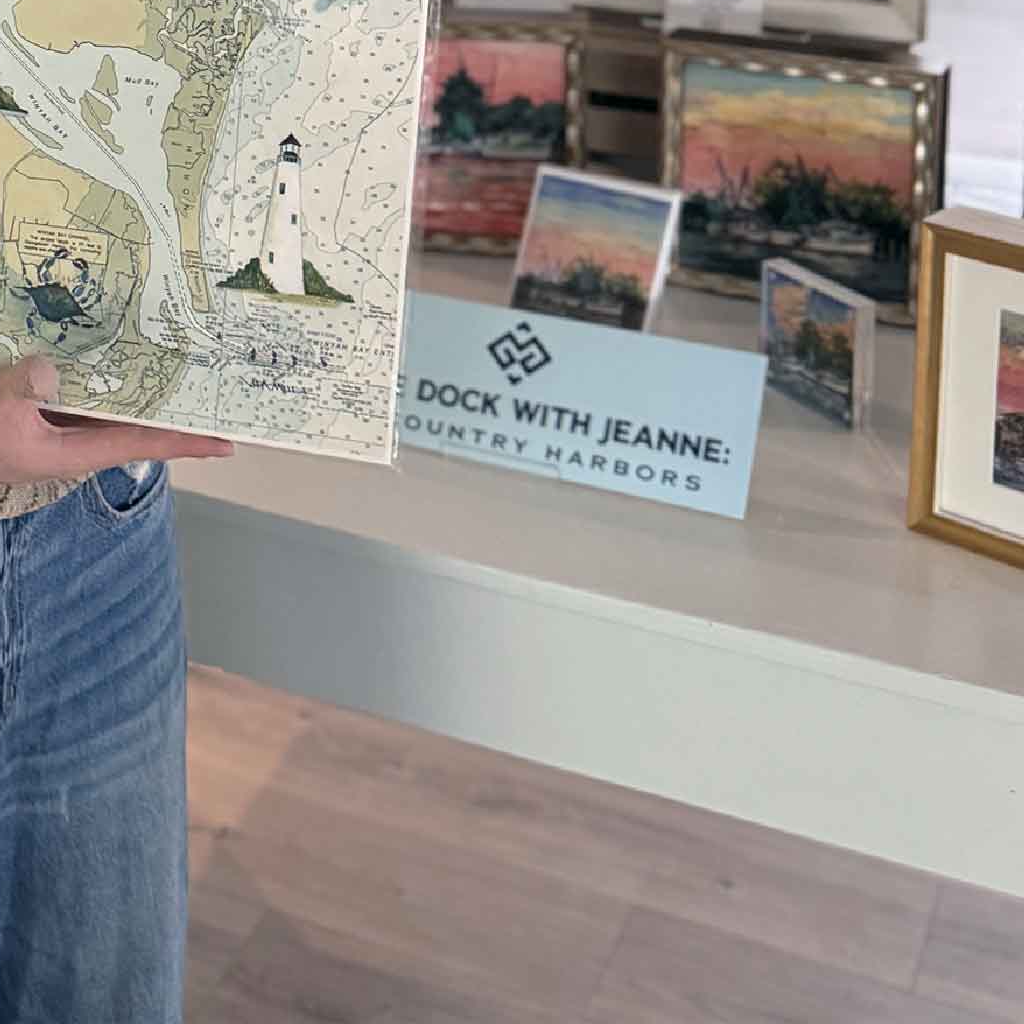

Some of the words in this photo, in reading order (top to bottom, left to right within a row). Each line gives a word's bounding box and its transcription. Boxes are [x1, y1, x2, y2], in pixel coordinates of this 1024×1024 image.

[397, 412, 529, 455] OUNTRY
[544, 444, 703, 492] HARBORS
[417, 378, 502, 417] DOCK
[513, 398, 593, 436] WITH
[598, 416, 732, 465] JEANNE:
